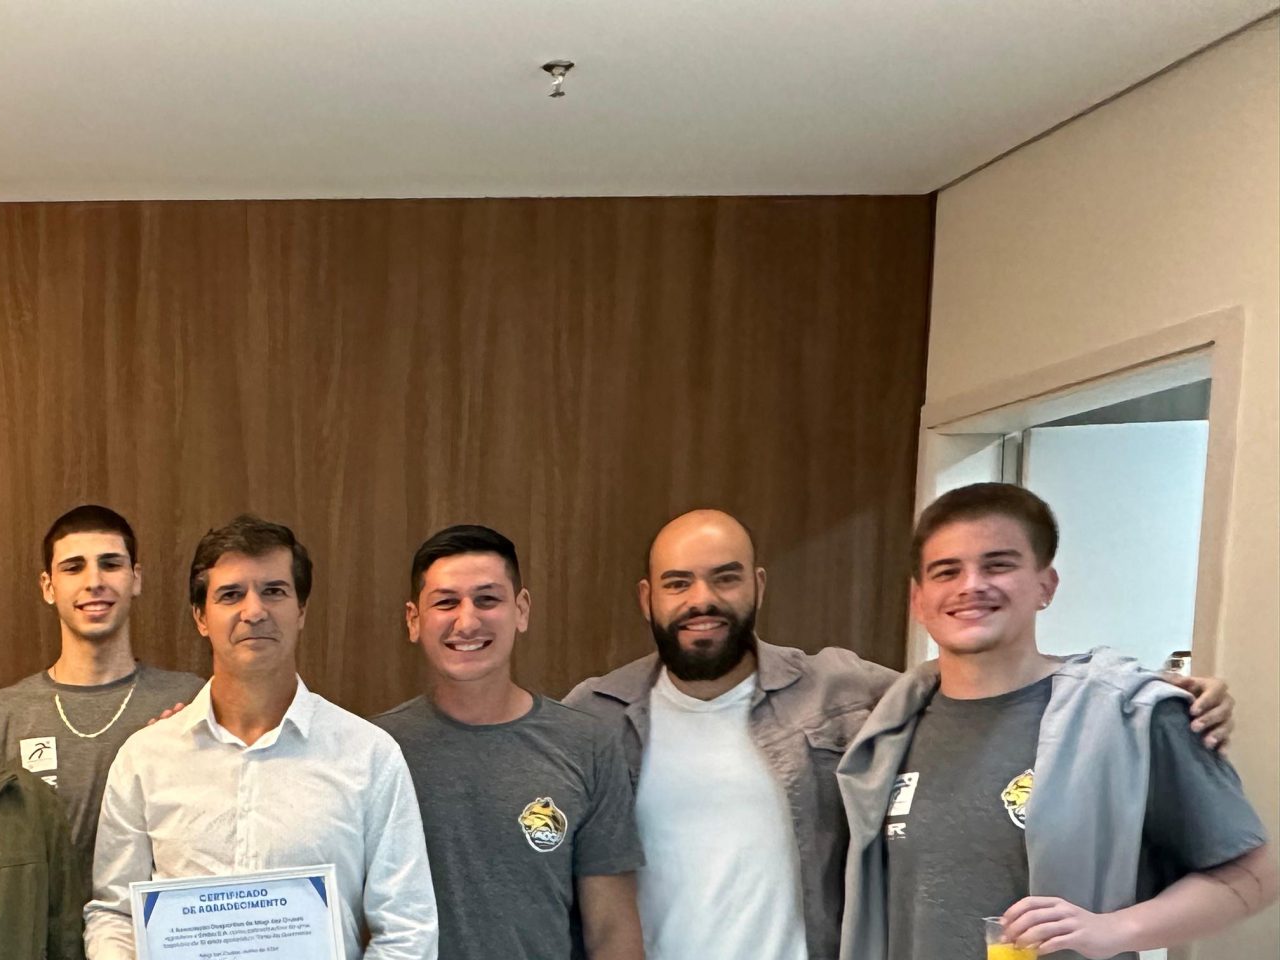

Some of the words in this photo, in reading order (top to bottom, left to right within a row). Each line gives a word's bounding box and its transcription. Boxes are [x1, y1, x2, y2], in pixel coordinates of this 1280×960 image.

[199, 888, 268, 902] CERTIFICADO
[182, 905, 197, 916] DE
[198, 897, 288, 914] AGRADECIMENTO
